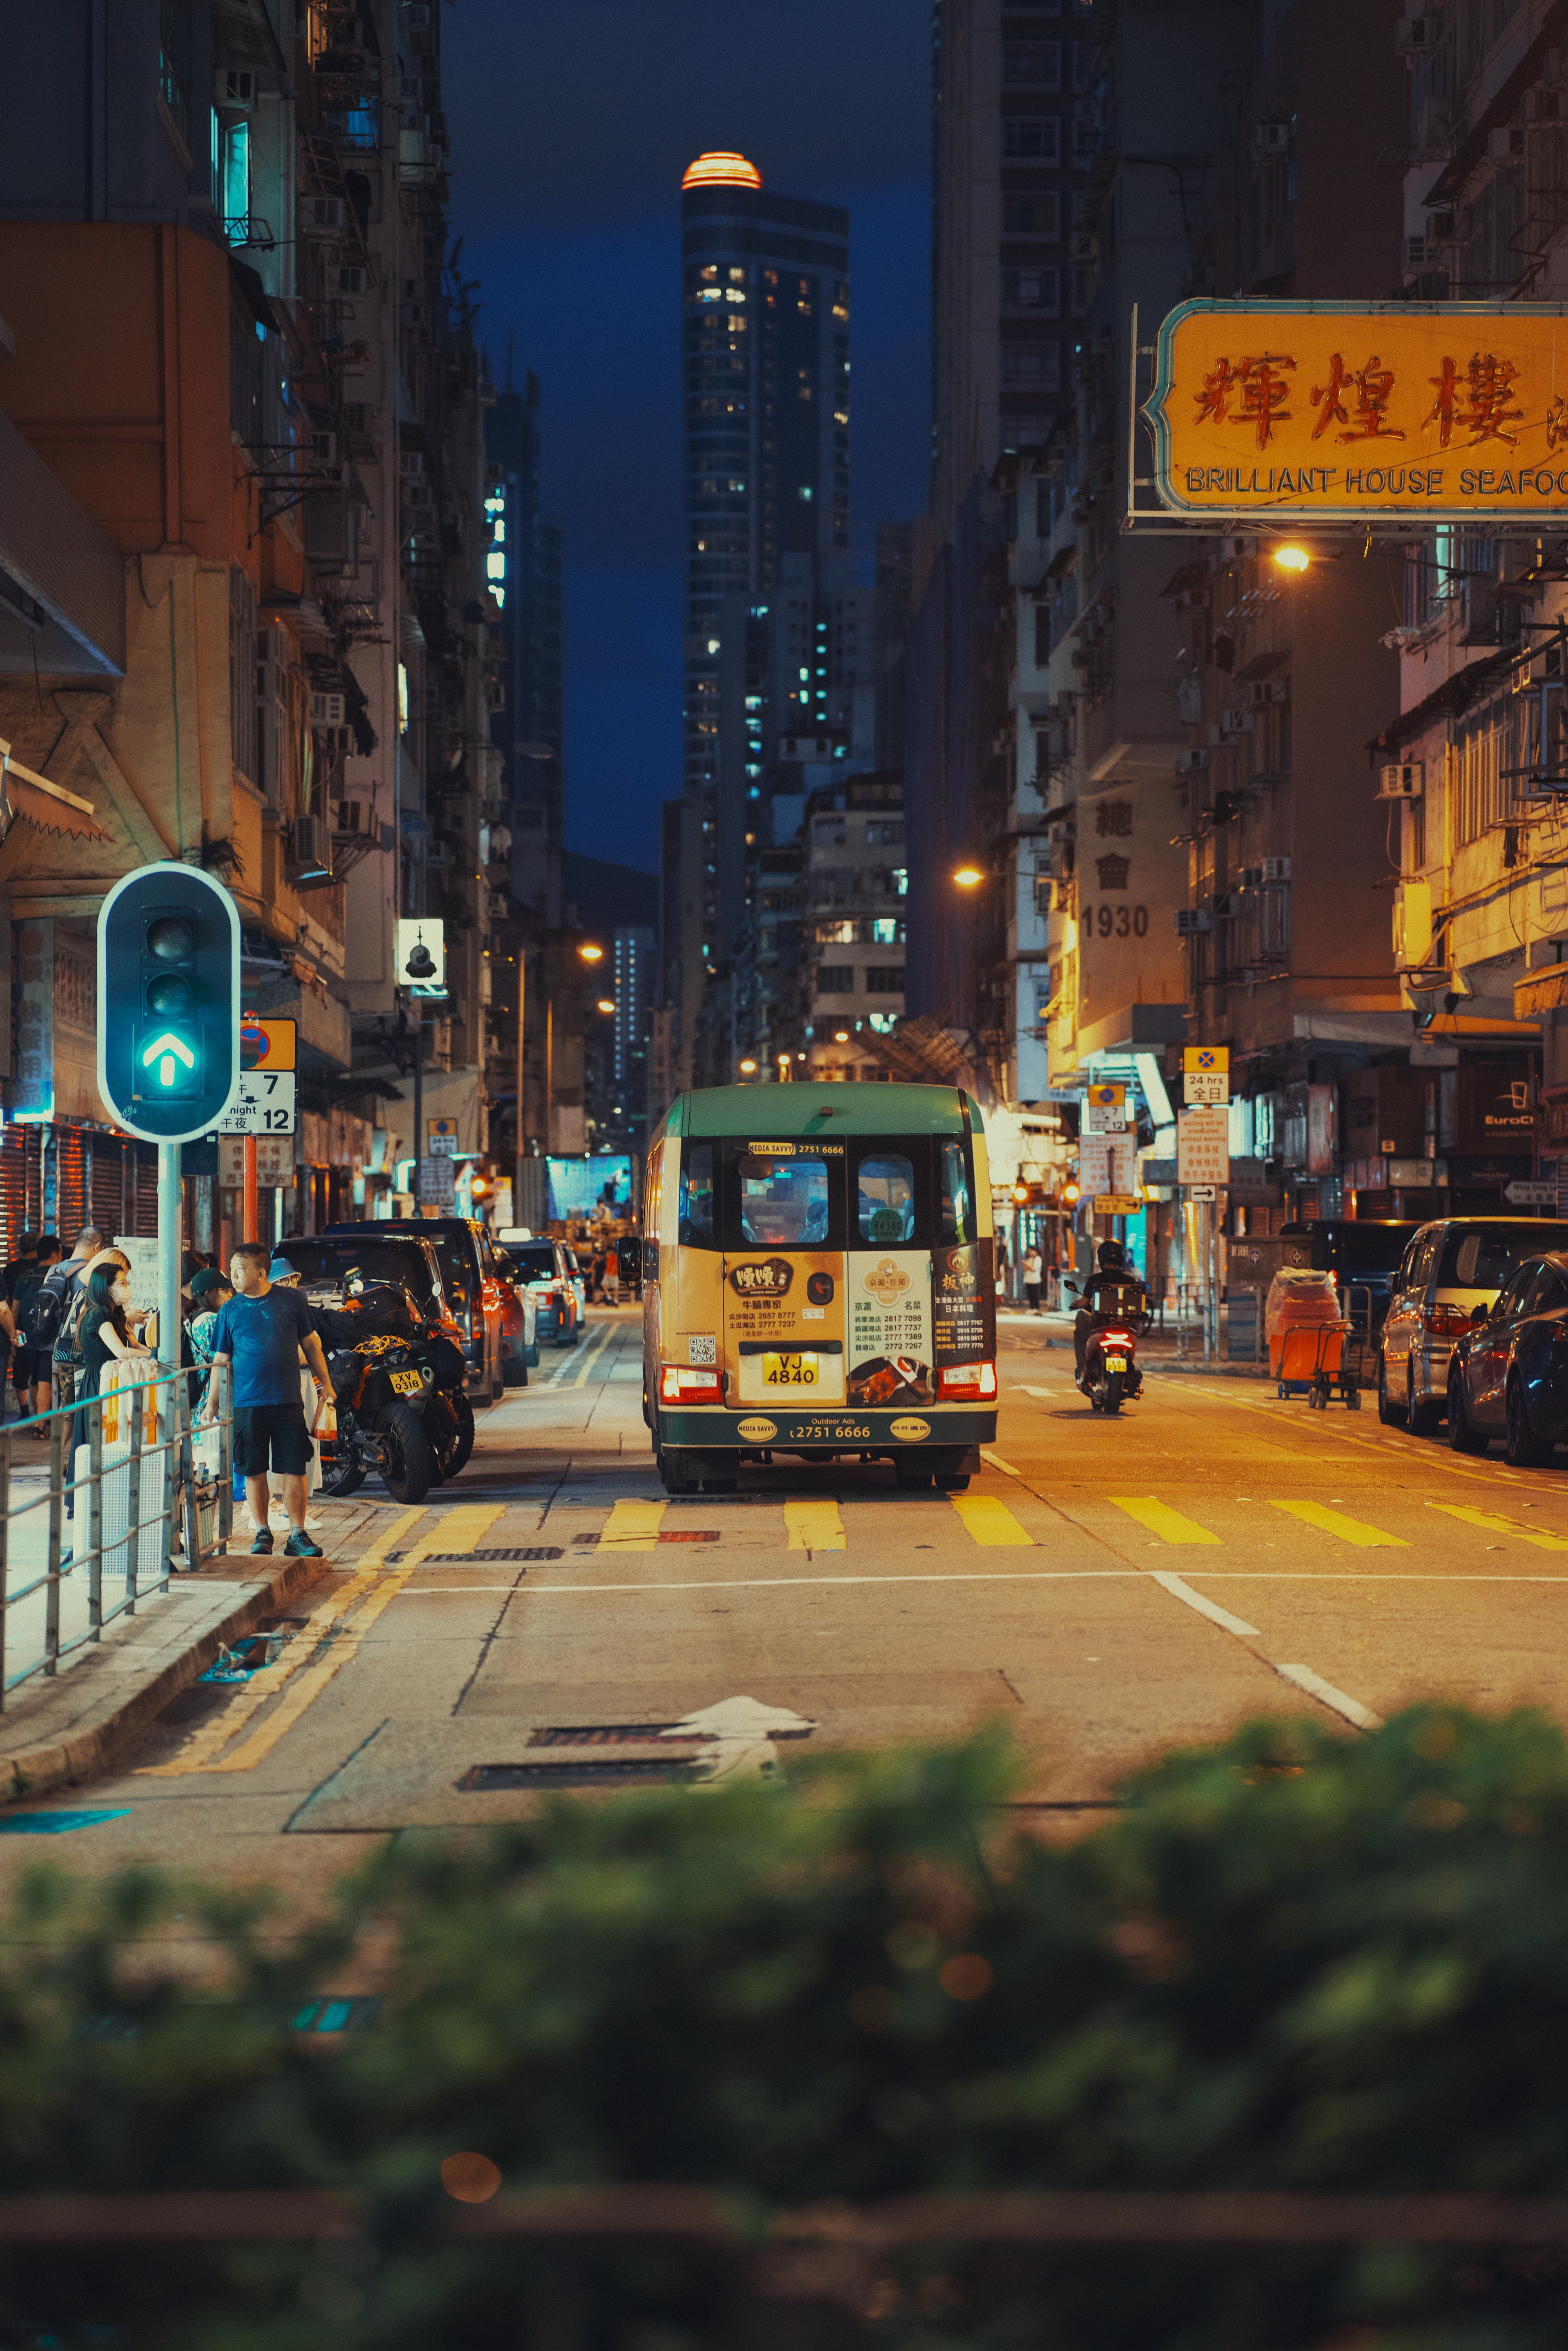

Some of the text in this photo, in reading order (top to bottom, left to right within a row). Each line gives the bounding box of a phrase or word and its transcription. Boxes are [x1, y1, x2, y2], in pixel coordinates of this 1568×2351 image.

[1193, 352, 1526, 450] 輝煌樓
[1187, 466, 1336, 493] BRILLIANT
[1346, 467, 1444, 495] HOUSE
[1082, 905, 1148, 938] 1930
[264, 1075, 278, 1094] 7
[1189, 1076, 1223, 1085] 24 hrs
[1193, 1088, 1221, 1100] 全日
[228, 1106, 256, 1116] night
[1112, 1108, 1118, 1116] 7
[263, 1109, 289, 1129] 12
[1113, 1121, 1123, 1130] 12
[736, 1266, 775, 1288] 順順
[742, 1300, 782, 1309] 牛腩專家
[904, 1301, 921, 1310] 名菜
[779, 1356, 802, 1369] VJ
[398, 1373, 410, 1382] XV
[768, 1370, 814, 1384] 4840
[395, 1380, 419, 1391] 9318
[797, 1426, 871, 1438] 2751 6666
